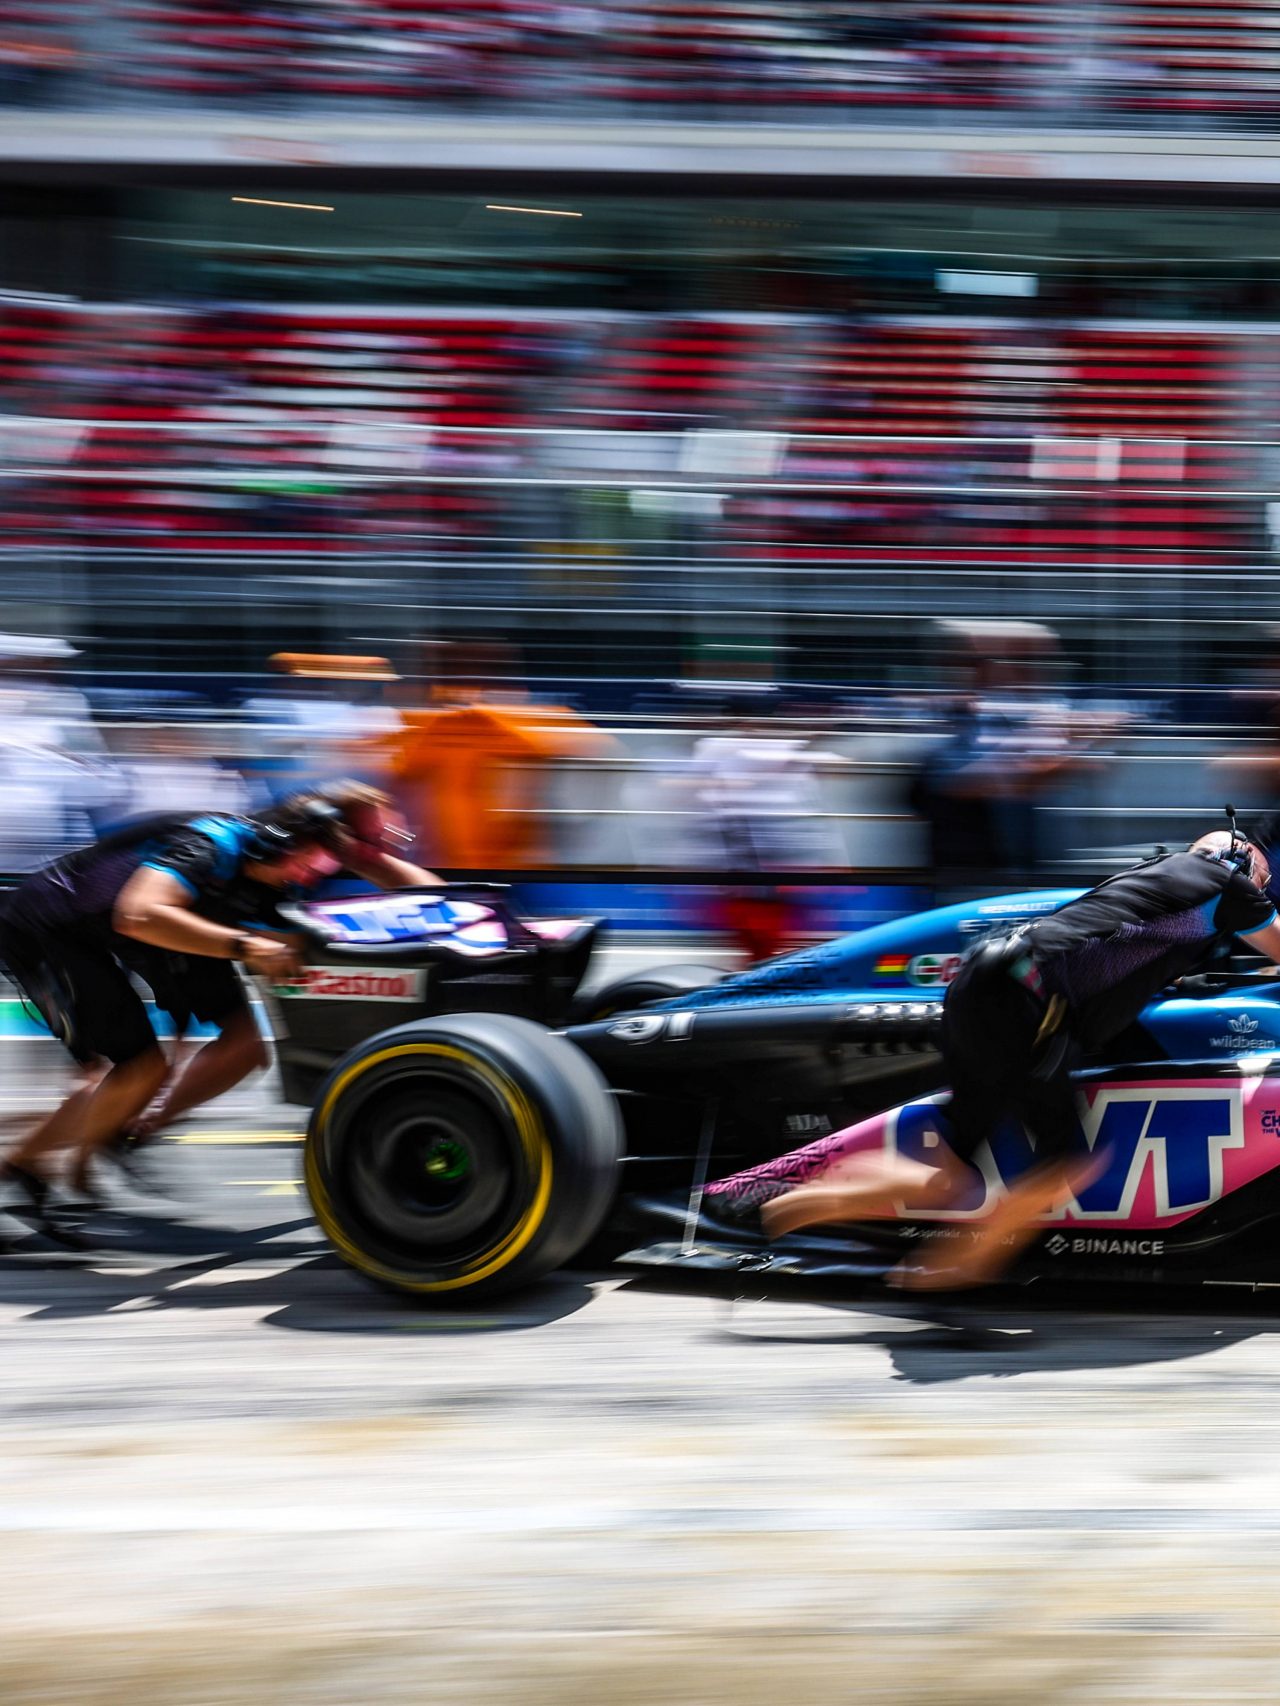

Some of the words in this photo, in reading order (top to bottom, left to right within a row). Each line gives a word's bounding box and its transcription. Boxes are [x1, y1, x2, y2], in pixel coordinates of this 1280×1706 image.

[1209, 1035, 1276, 1049] wildbean
[970, 1230, 1017, 1246] yao!
[1072, 1239, 1165, 1255] BINANCE
